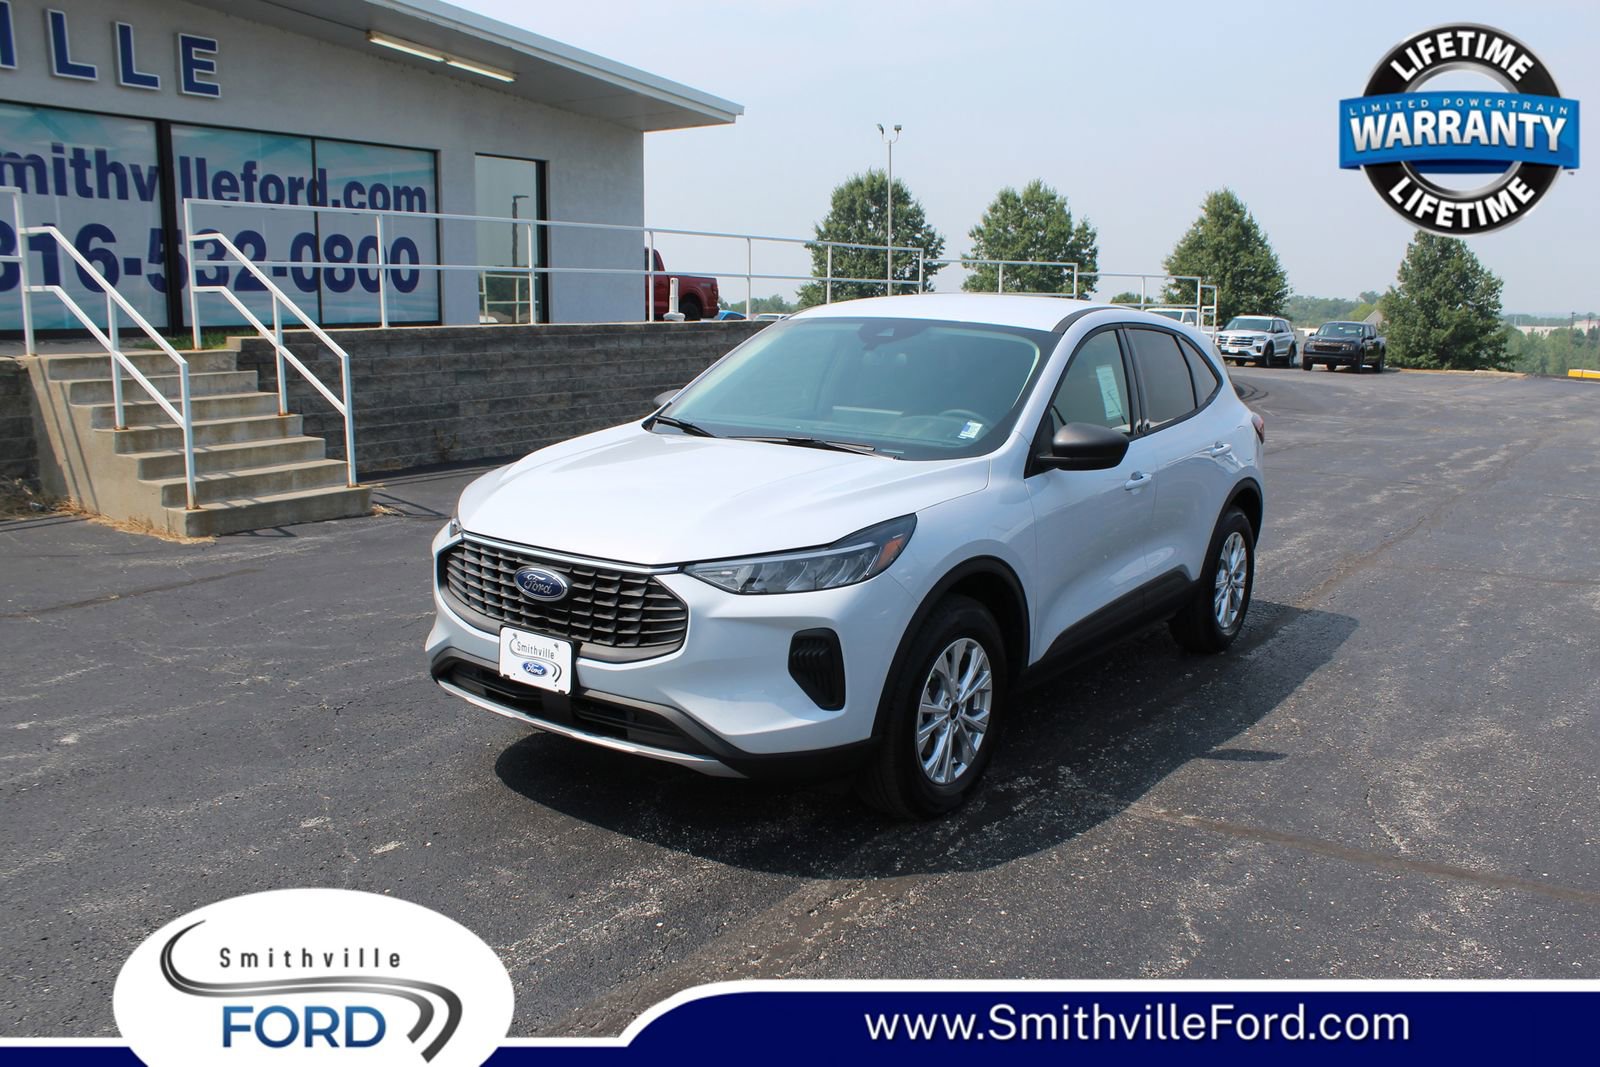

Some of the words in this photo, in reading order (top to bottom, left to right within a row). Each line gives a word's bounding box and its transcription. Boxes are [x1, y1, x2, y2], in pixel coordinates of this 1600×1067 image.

[0, 142, 428, 215] mithvlleford.com
[523, 573, 554, 596] Ford
[516, 640, 555, 660] Smithville
[525, 661, 544, 676] Ford
